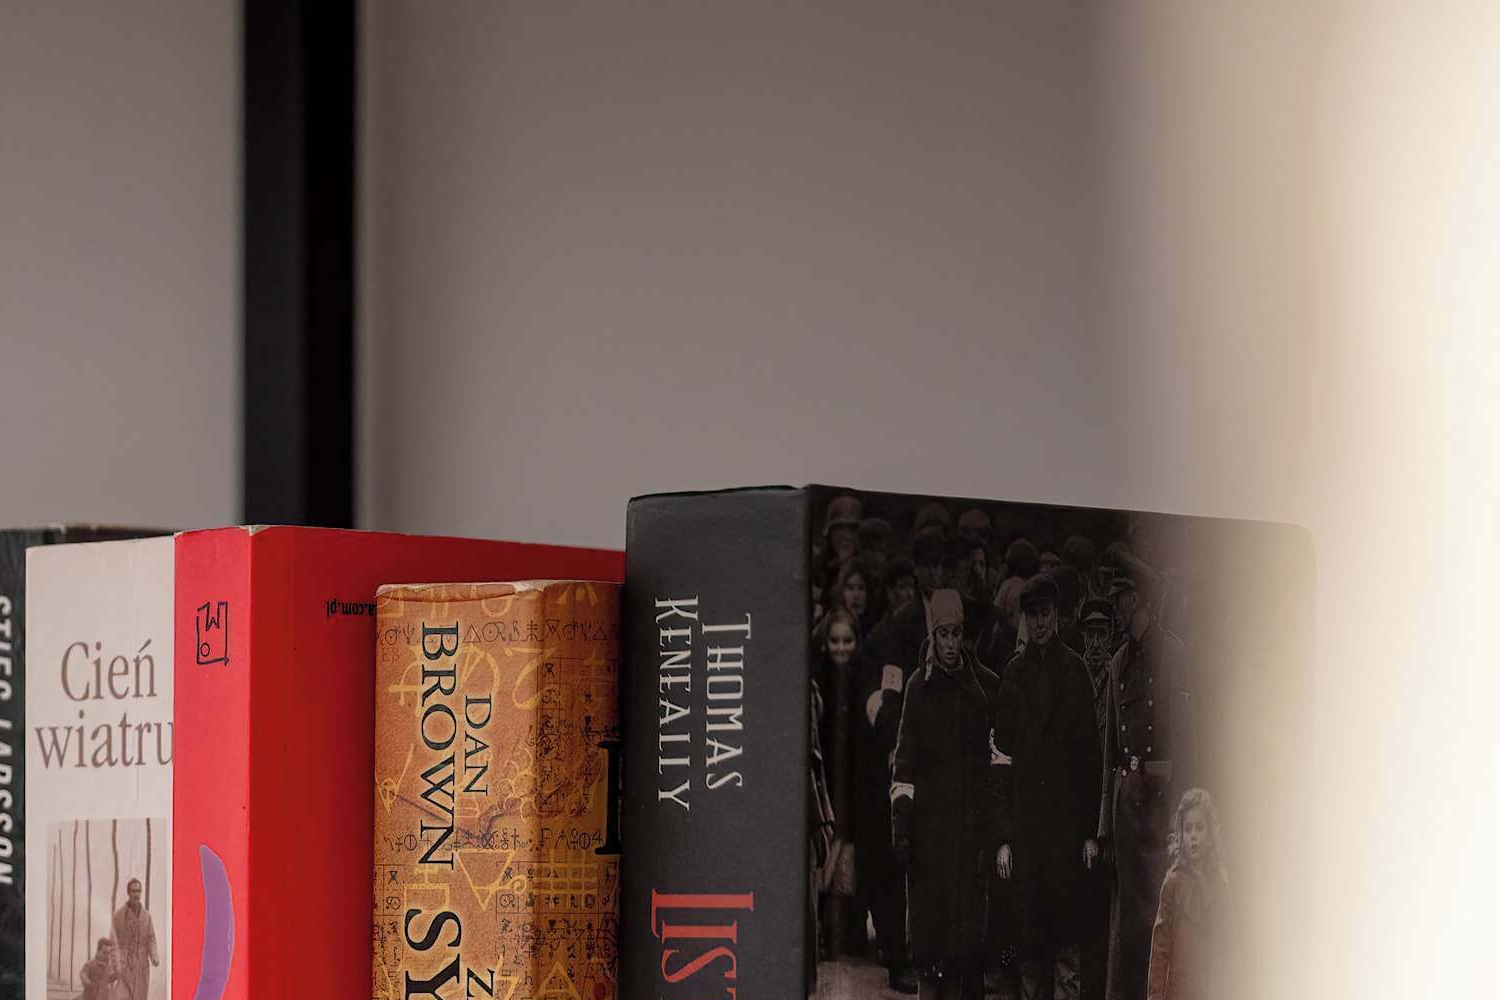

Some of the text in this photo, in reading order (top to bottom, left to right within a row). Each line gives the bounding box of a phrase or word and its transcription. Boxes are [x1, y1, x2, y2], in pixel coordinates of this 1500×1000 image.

[34, 709, 174, 770] wiatru
[60, 637, 158, 702] Cień
[653, 594, 699, 812] KENEALLY
[701, 612, 752, 791] THOMAS
[417, 620, 460, 871] BROWN
[462, 693, 492, 797] DAN
